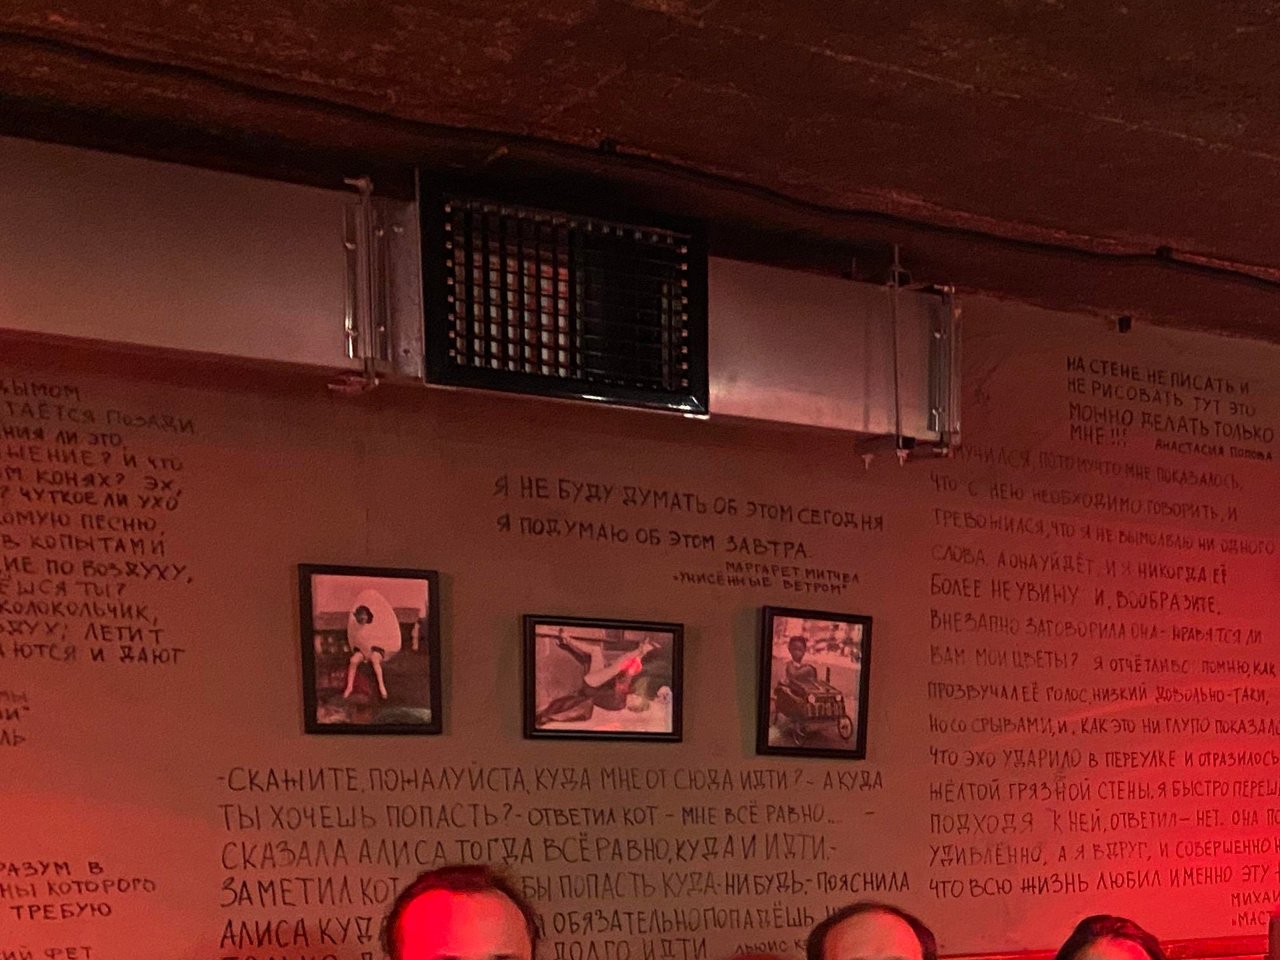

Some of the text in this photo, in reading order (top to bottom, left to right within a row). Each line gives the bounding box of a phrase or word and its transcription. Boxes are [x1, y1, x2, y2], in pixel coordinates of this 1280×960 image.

[1067, 357, 1248, 394] НА СТЕНЕ НЕ ПИСАТЬ И
[1068, 378, 1256, 417] НЕ РИСОВАТЬ ТУТ ЭТО
[56, 430, 78, 445] ЛИ
[1070, 424, 1104, 445] МНЕ
[1141, 413, 1274, 443] ДЕЛАТЬ ТОЛЬКО
[36, 470, 125, 488] КОНЯХ?
[20, 488, 178, 511] ЧУТКОЕ ЛИ УХО
[494, 477, 884, 532] Я НЕ БУДУ ДУМАТЬ ОБ ЭТОМ СЕГОДНЯ
[497, 514, 715, 551] Я ПОДУМАЮ ОБ ЭТОМ
[30, 534, 165, 556] КОПЫТАМИ
[47, 559, 74, 576] ПО
[726, 560, 801, 577] МАРГАРЕТ
[85, 622, 164, 644] ЛЕТИТ
[91, 648, 185, 664] И ДАЮТ
[1081, 718, 1209, 733] КАК ЭТО НИ ГЛУПО
[929, 749, 1279, 768] ЧТО ЭХО УДАРИЛО ПЕРЕУЛКЕ ОТРАЗИЛОСЬ
[1172, 780, 1229, 798] БЫСТРО
[218, 802, 757, 830] ТЫ ХОЧЕШЬ ОТВЕТИЛ КОТ МНЕ ВСЁ
[930, 813, 1034, 835] ПОДХОДЯ
[1232, 810, 1258, 826] ОНА
[221, 838, 534, 870] СКАЗАЛА АЛИСА ТОГДА
[1176, 838, 1271, 858] СОВЕРШЕННО
[89, 861, 103, 874] В
[49, 878, 156, 898] КОТОРОГО
[221, 877, 351, 907] ЗАМЕТИЛ
[559, 872, 910, 899] ПОПАСТЬ ПОЯСНИЛА
[929, 863, 1269, 899] ЧТО ВСЮ ЖИЗНЬ ЛЮБИЛ ИМЕННО ЭТУ
[10, 902, 112, 920] ТРЕБУЮ
[553, 902, 814, 936] ОБЯЗАТЕЛЬНО ПОПАДЁШЬ
[220, 919, 308, 948] АЛИСА
[44, 946, 92, 960] ФЕТ
